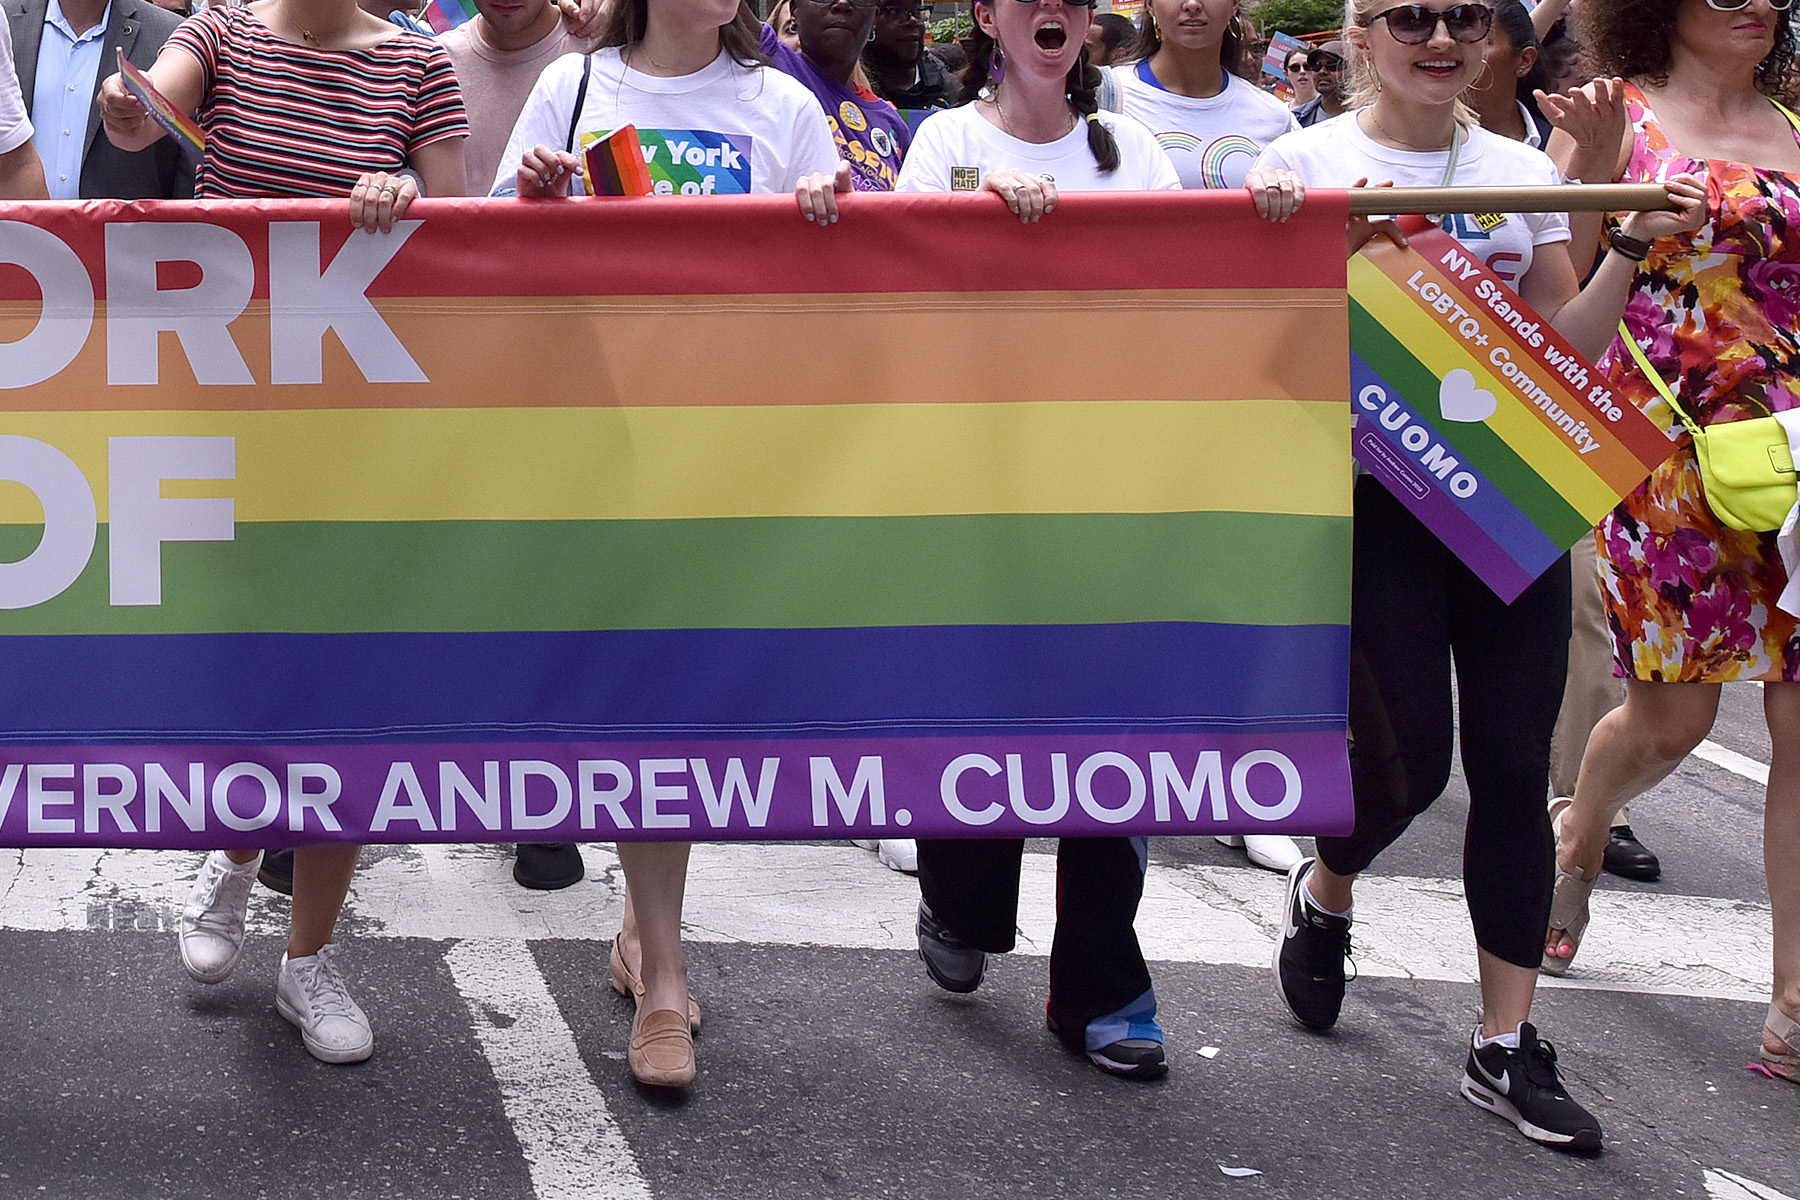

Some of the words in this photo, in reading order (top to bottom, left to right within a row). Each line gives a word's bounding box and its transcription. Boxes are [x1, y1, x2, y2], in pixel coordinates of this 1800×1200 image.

[665, 140, 742, 170] York
[954, 168, 966, 179] NO
[680, 175, 716, 195] of
[954, 179, 977, 189] HATE
[1406, 270, 1490, 347] LGBTQ+
[1489, 346, 1601, 455] Community
[1440, 248, 1481, 281] NY
[1474, 277, 1545, 349] Stands
[1543, 345, 1590, 392] with
[1587, 385, 1623, 423] the
[1358, 384, 1478, 499] CUOMO
[367, 756, 782, 833] ANDREW
[808, 754, 913, 830] M.
[939, 749, 1303, 826] CUOMO
